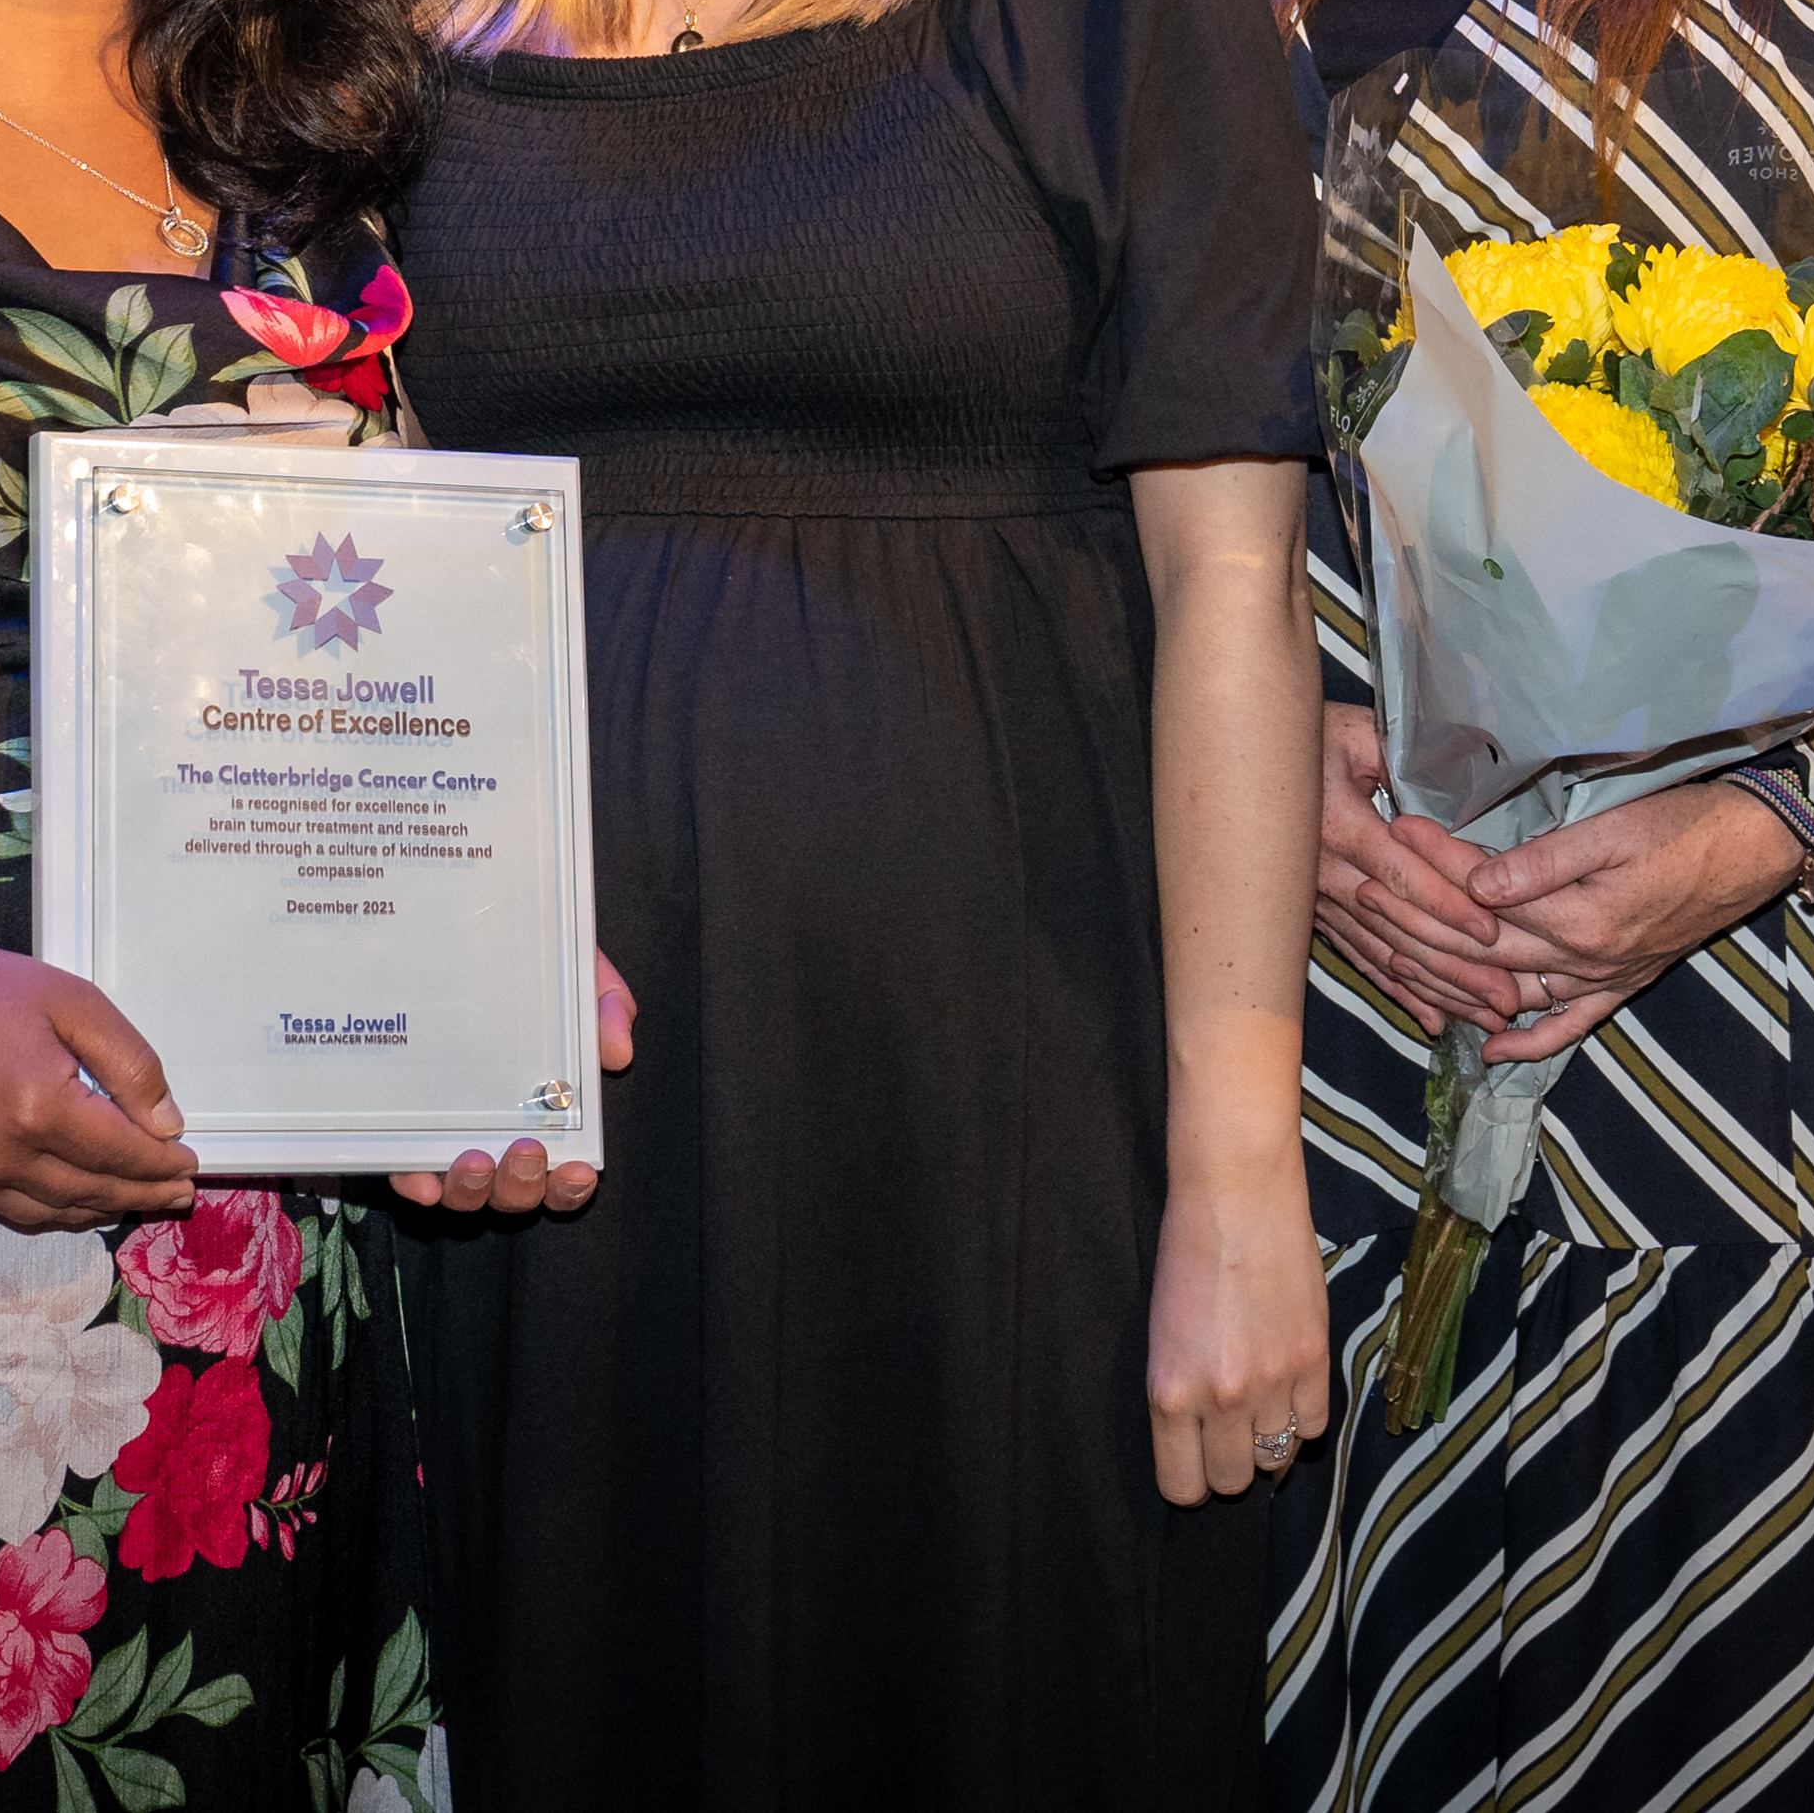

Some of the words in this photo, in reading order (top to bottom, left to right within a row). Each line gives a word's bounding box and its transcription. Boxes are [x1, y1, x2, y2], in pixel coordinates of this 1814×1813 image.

[1330, 405, 1351, 433] FLO
[238, 669, 328, 701] Tessa
[336, 672, 434, 704] Jowell
[202, 704, 291, 733] Centre
[298, 709, 324, 734] of
[331, 709, 471, 738] Excellence
[177, 763, 214, 784] The
[219, 764, 353, 793] Clatterbridge
[358, 768, 427, 789] Cancer
[432, 770, 497, 791] Centre
[231, 795, 243, 810] is
[248, 797, 327, 814] recognised
[332, 798, 351, 813] for
[355, 799, 429, 814] excellence
[434, 800, 447, 815] in
[209, 817, 246, 832] brain
[250, 818, 302, 834] tumour
[306, 820, 374, 835] treatment
[377, 821, 403, 836] and
[408, 822, 468, 837] research
[185, 839, 251, 854] delivered
[255, 840, 312, 858] through
[316, 843, 325, 855] a
[328, 841, 378, 857] culture
[382, 843, 396, 857] of
[400, 842, 463, 859] kindness
[467, 844, 493, 859] and
[297, 864, 384, 881] compassion
[286, 899, 358, 914] December
[362, 900, 396, 915] 2021
[279, 1013, 335, 1033] Tessa
[342, 1013, 407, 1033] Jowell
[284, 1034, 316, 1045] BRAIN
[319, 1034, 362, 1045] CANCER
[364, 1034, 408, 1046] MISSION
